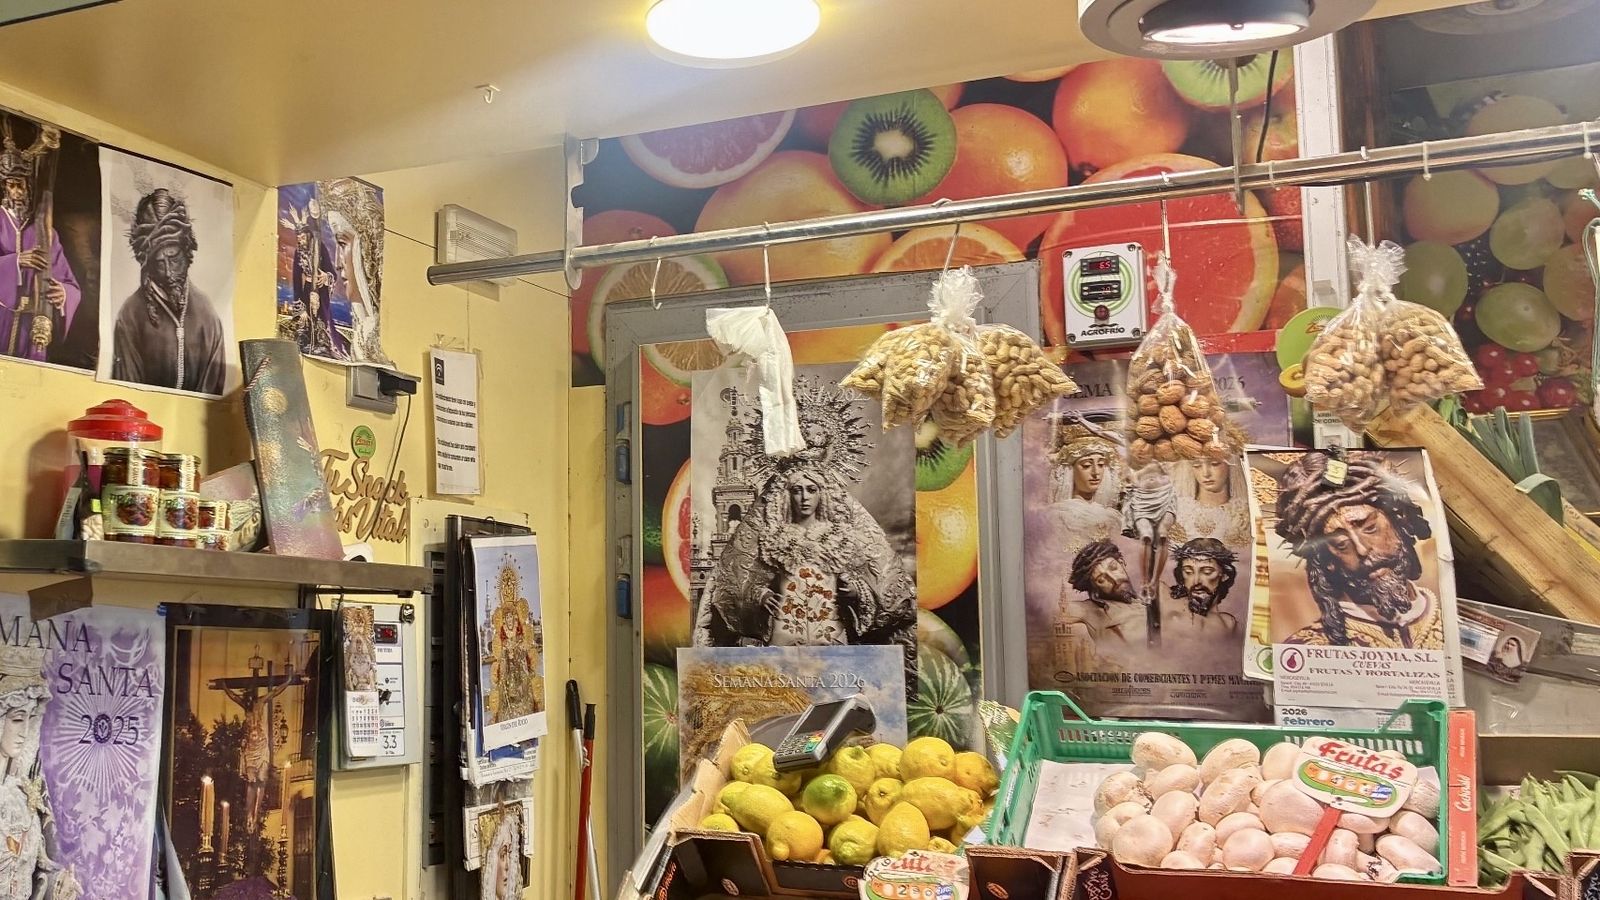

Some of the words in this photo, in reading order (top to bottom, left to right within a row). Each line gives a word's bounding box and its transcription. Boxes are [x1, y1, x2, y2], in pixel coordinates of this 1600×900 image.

[1307, 648, 1356, 661] FRUTAS
[1352, 661, 1391, 669] CUEVAS
[1121, 672, 1133, 682] DE
[1309, 667, 1353, 676] FRUTAS
[1365, 669, 1440, 678] HORTALIZAS
[57, 662, 154, 699] SANTA
[713, 673, 773, 688] SEMANA
[777, 673, 826, 688] SANTA
[827, 673, 866, 688] 2026
[1281, 708, 1308, 716] 2026
[1282, 717, 1336, 727] febrero
[79, 714, 139, 746] 2025
[1318, 741, 1405, 780] Frutas
